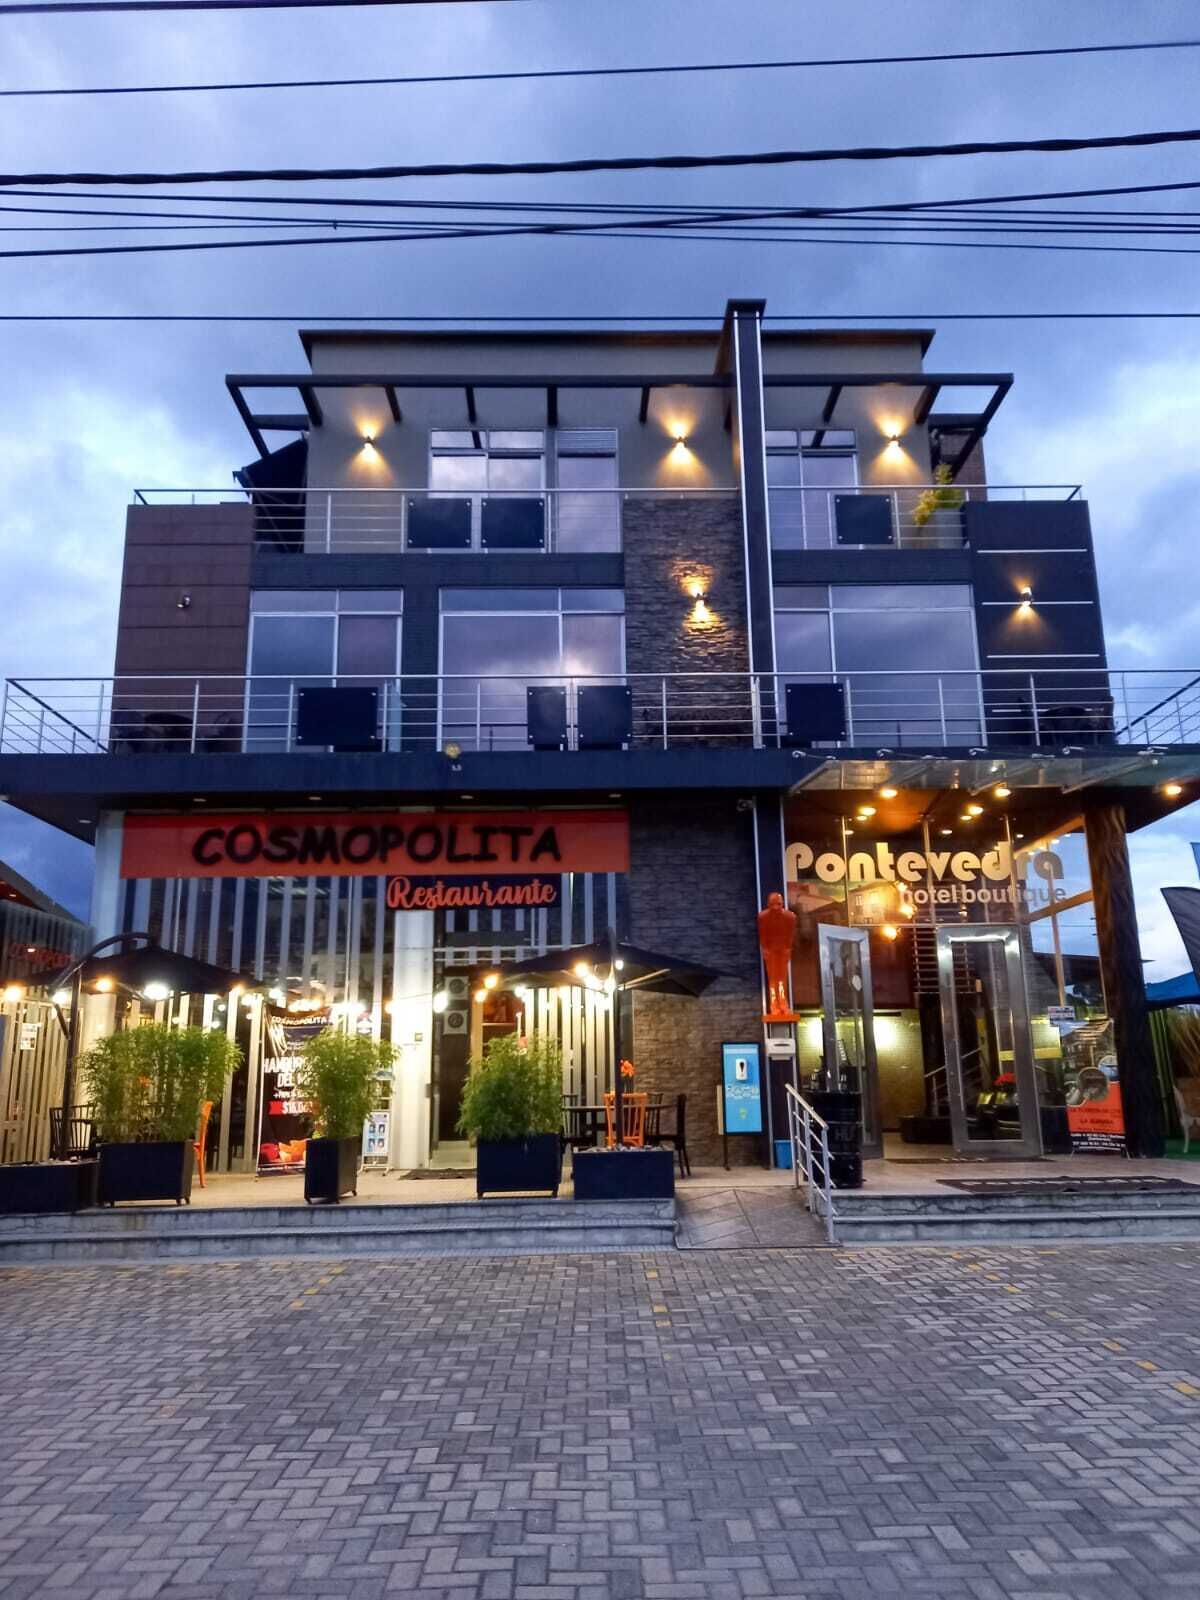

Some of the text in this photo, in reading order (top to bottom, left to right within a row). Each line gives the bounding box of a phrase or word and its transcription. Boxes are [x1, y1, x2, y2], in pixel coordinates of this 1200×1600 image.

[192, 824, 562, 865] COSMOPOLITA
[786, 842, 1064, 883] Pontevedra
[386, 876, 557, 909] Restaurante
[902, 884, 1066, 907] hotel boutique
